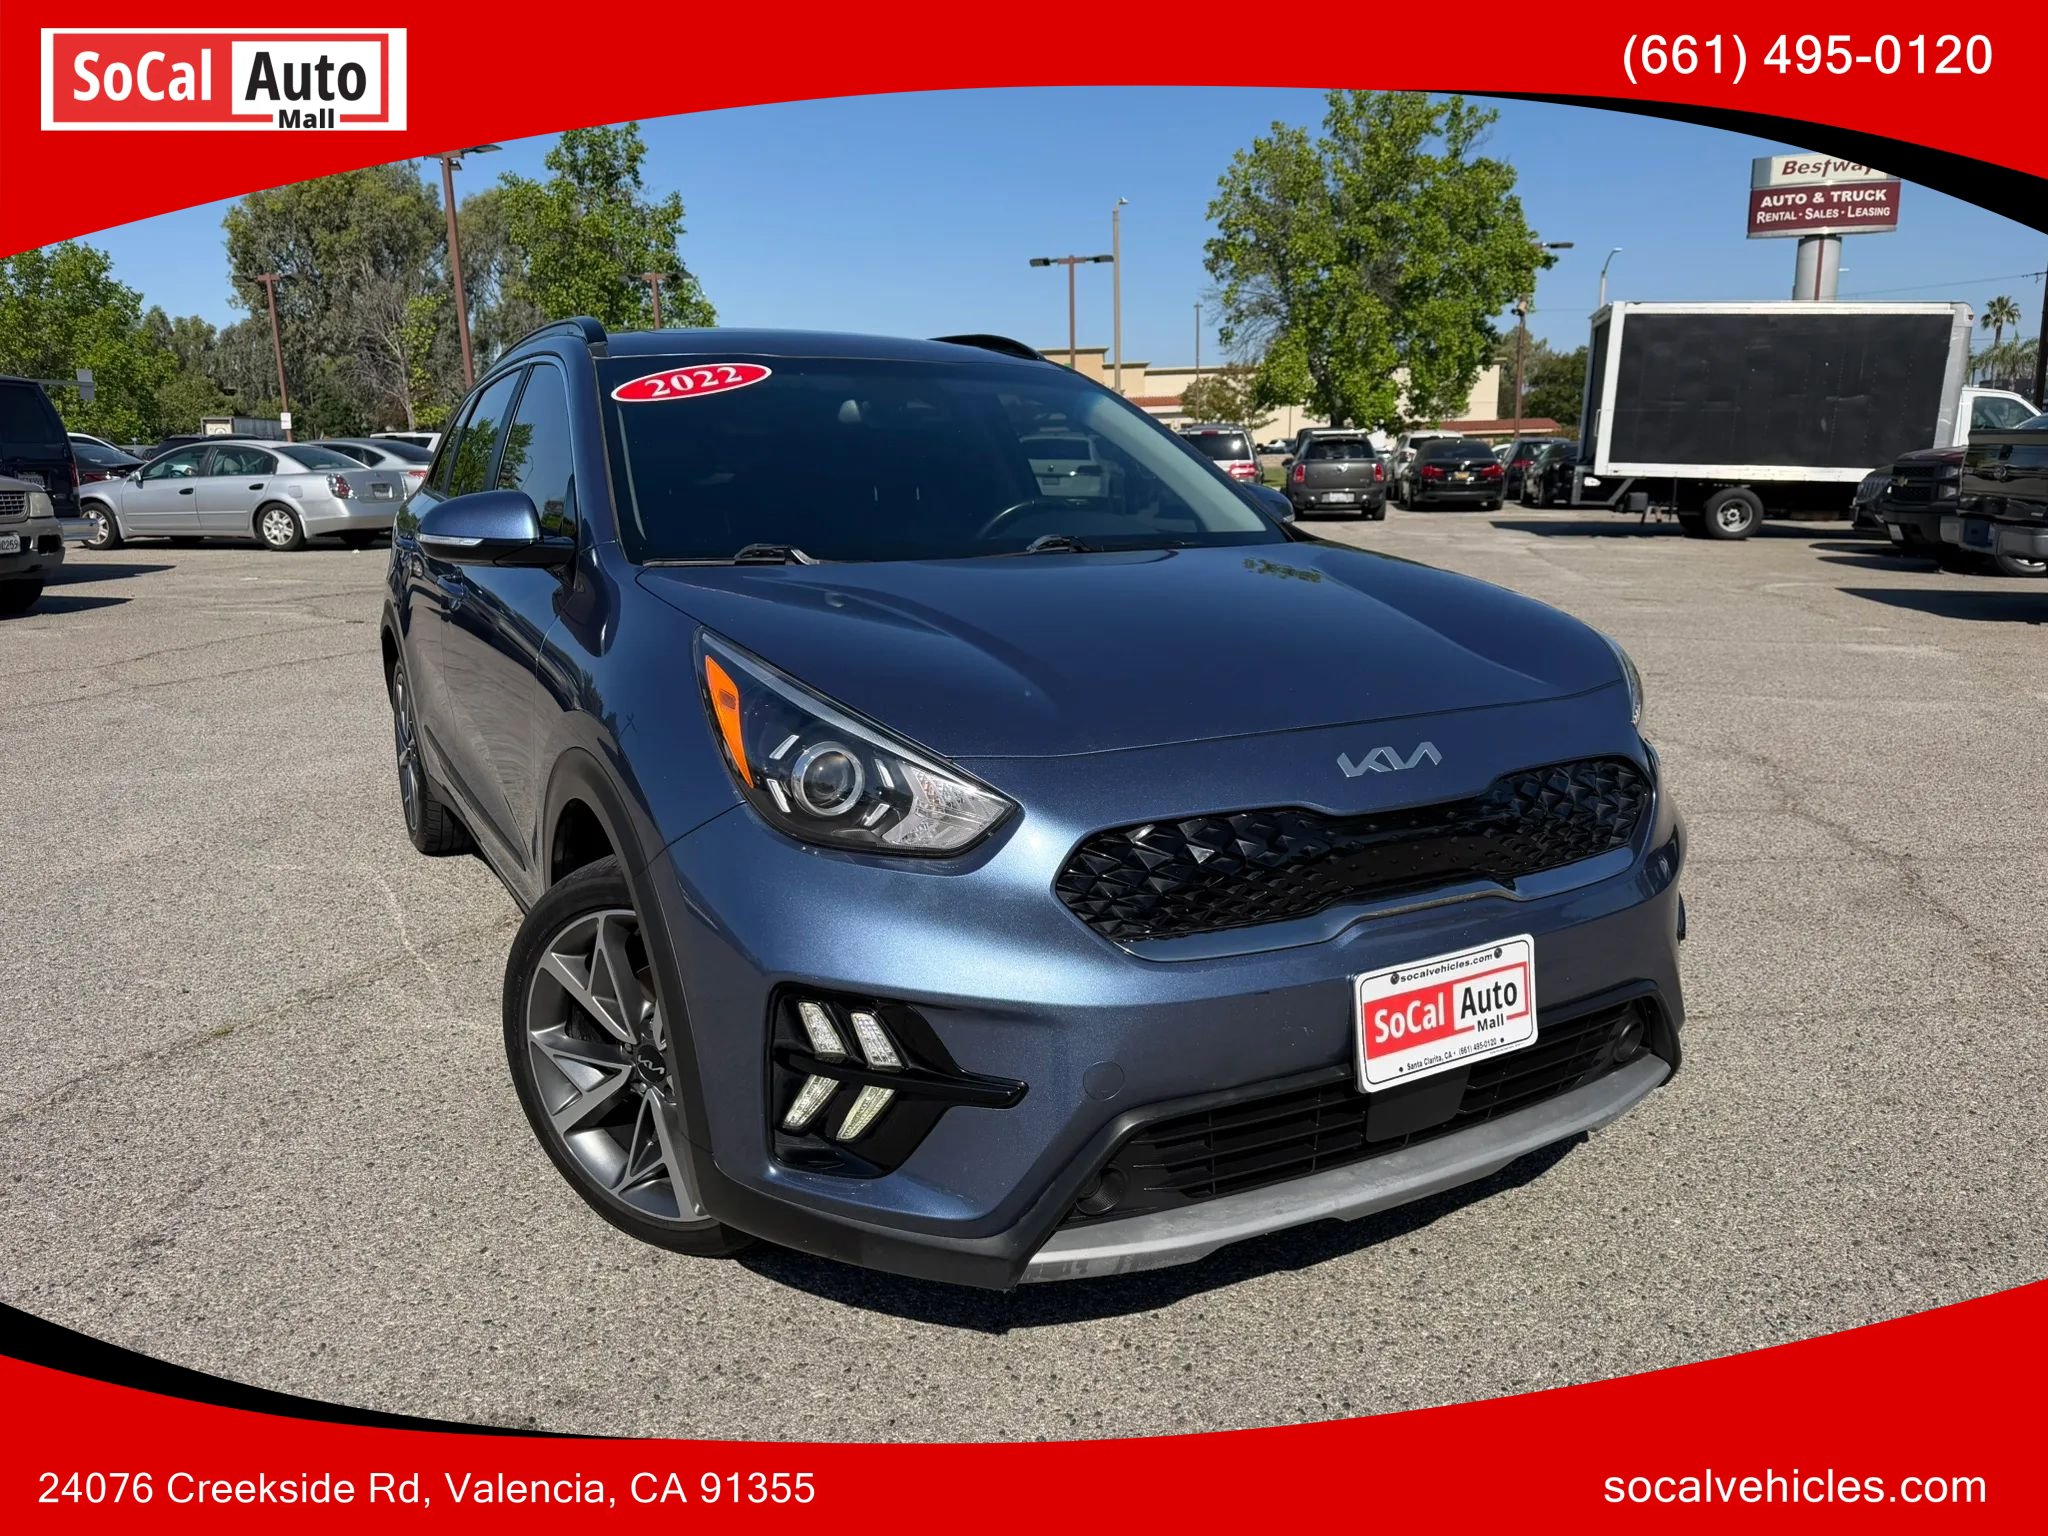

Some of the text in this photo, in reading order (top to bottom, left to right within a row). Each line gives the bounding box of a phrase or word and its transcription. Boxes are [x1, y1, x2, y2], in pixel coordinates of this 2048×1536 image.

[1760, 189, 1888, 208] AUTO & TRUCK
[1756, 205, 1890, 224] RENTAL SALES LEASING
[644, 366, 743, 397] 2022
[1400, 953, 1493, 983] socalvehicles.com
[1374, 980, 1518, 1044] SoCal Auto
[1477, 1013, 1505, 1033] Mall
[1406, 1057, 1423, 1071] Santa
[1444, 1049, 1453, 1059] CA
[1458, 1045, 1473, 1057] (661)
[1473, 1037, 1497, 1052] 495-0120
